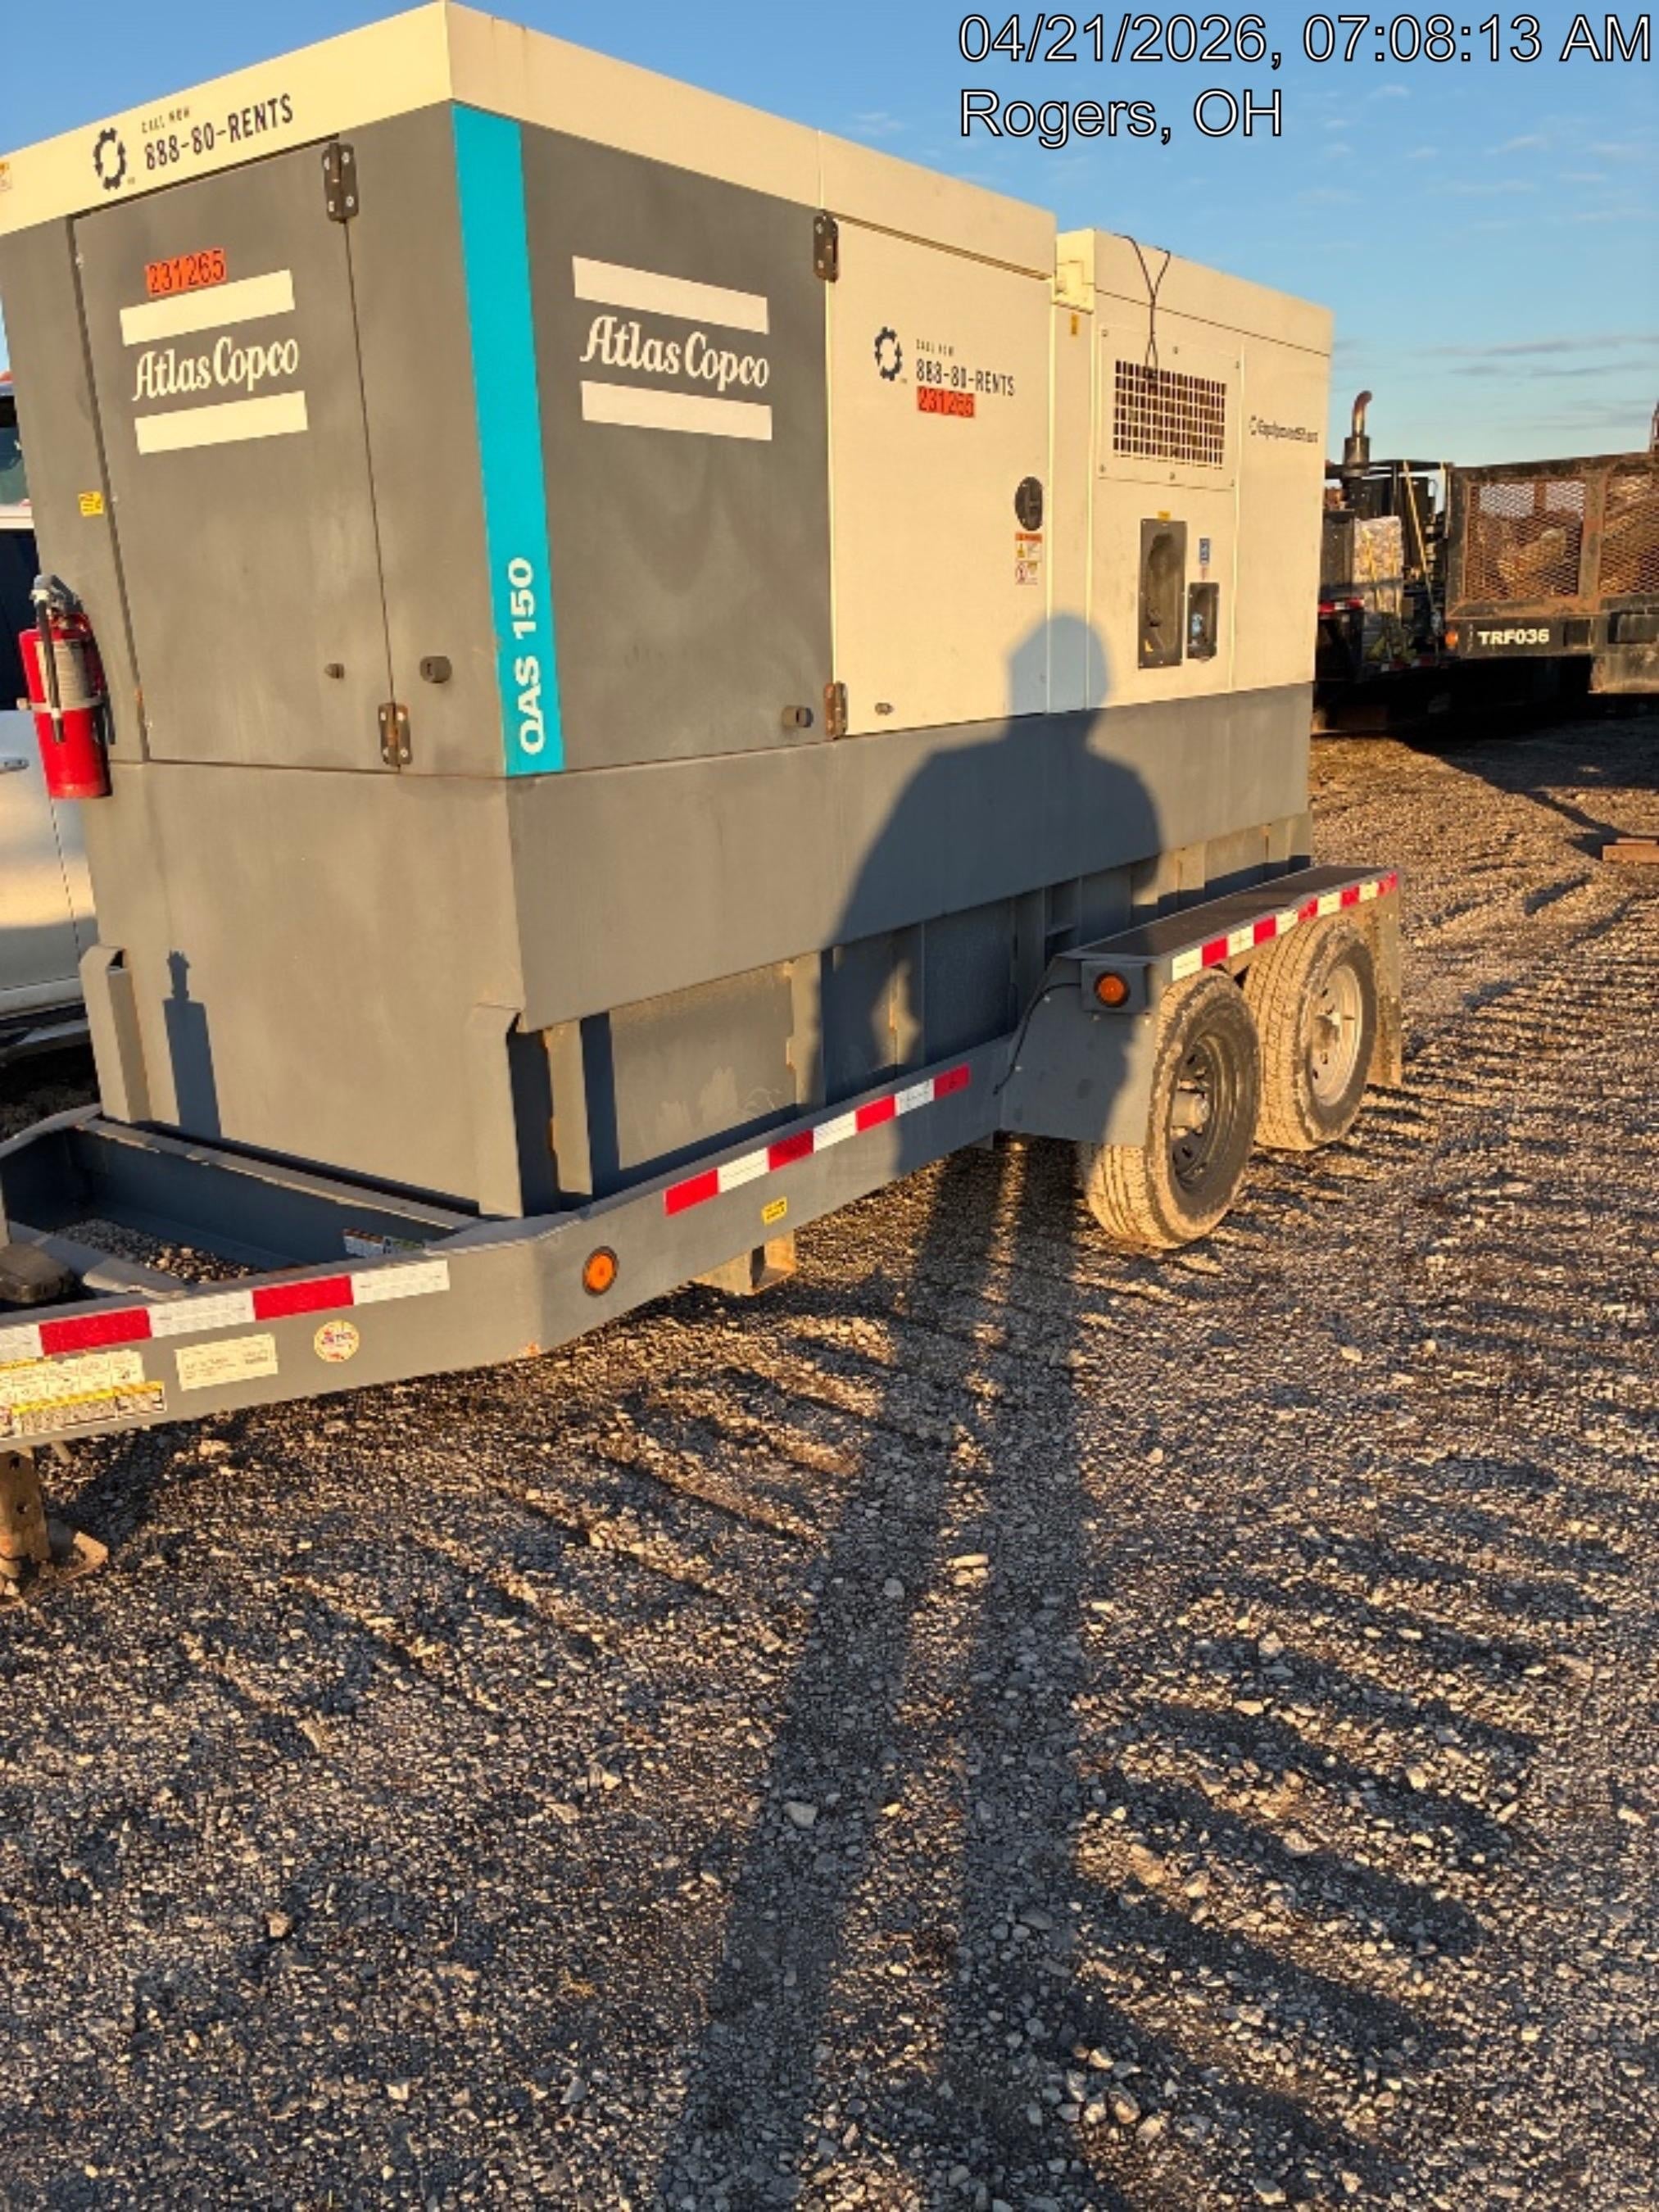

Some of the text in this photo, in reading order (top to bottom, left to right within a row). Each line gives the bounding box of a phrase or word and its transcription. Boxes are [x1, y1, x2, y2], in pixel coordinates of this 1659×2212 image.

[144, 93, 293, 170] 888-80-RENTS
[147, 249, 225, 294] 231265
[507, 556, 546, 755] QAS 150
[1477, 628, 1550, 646] TRF036
